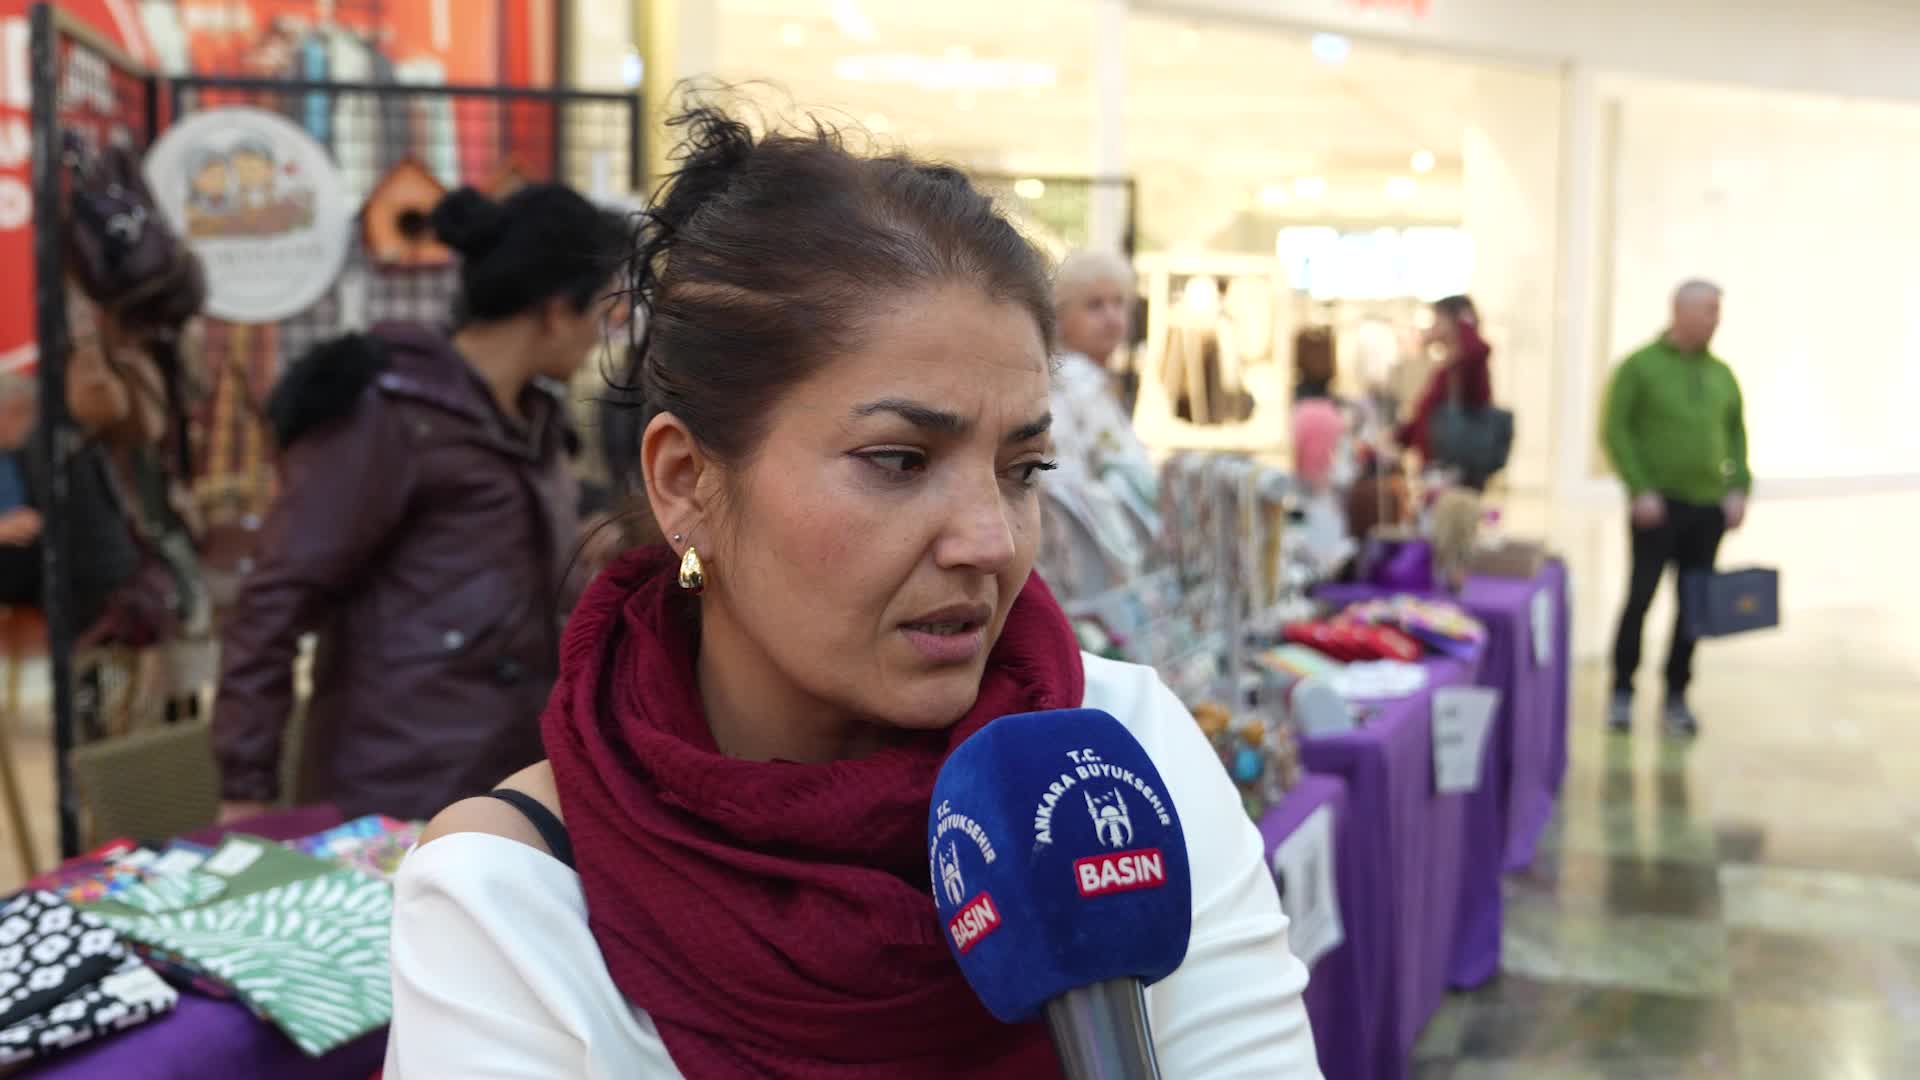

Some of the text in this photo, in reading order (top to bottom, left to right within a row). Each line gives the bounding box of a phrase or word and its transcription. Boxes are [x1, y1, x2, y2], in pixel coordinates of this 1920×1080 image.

[1067, 748, 1101, 763] T.C.
[1035, 774, 1077, 844] ANKARA
[1079, 853, 1162, 892] BASIN
[951, 898, 996, 949] BASIN
